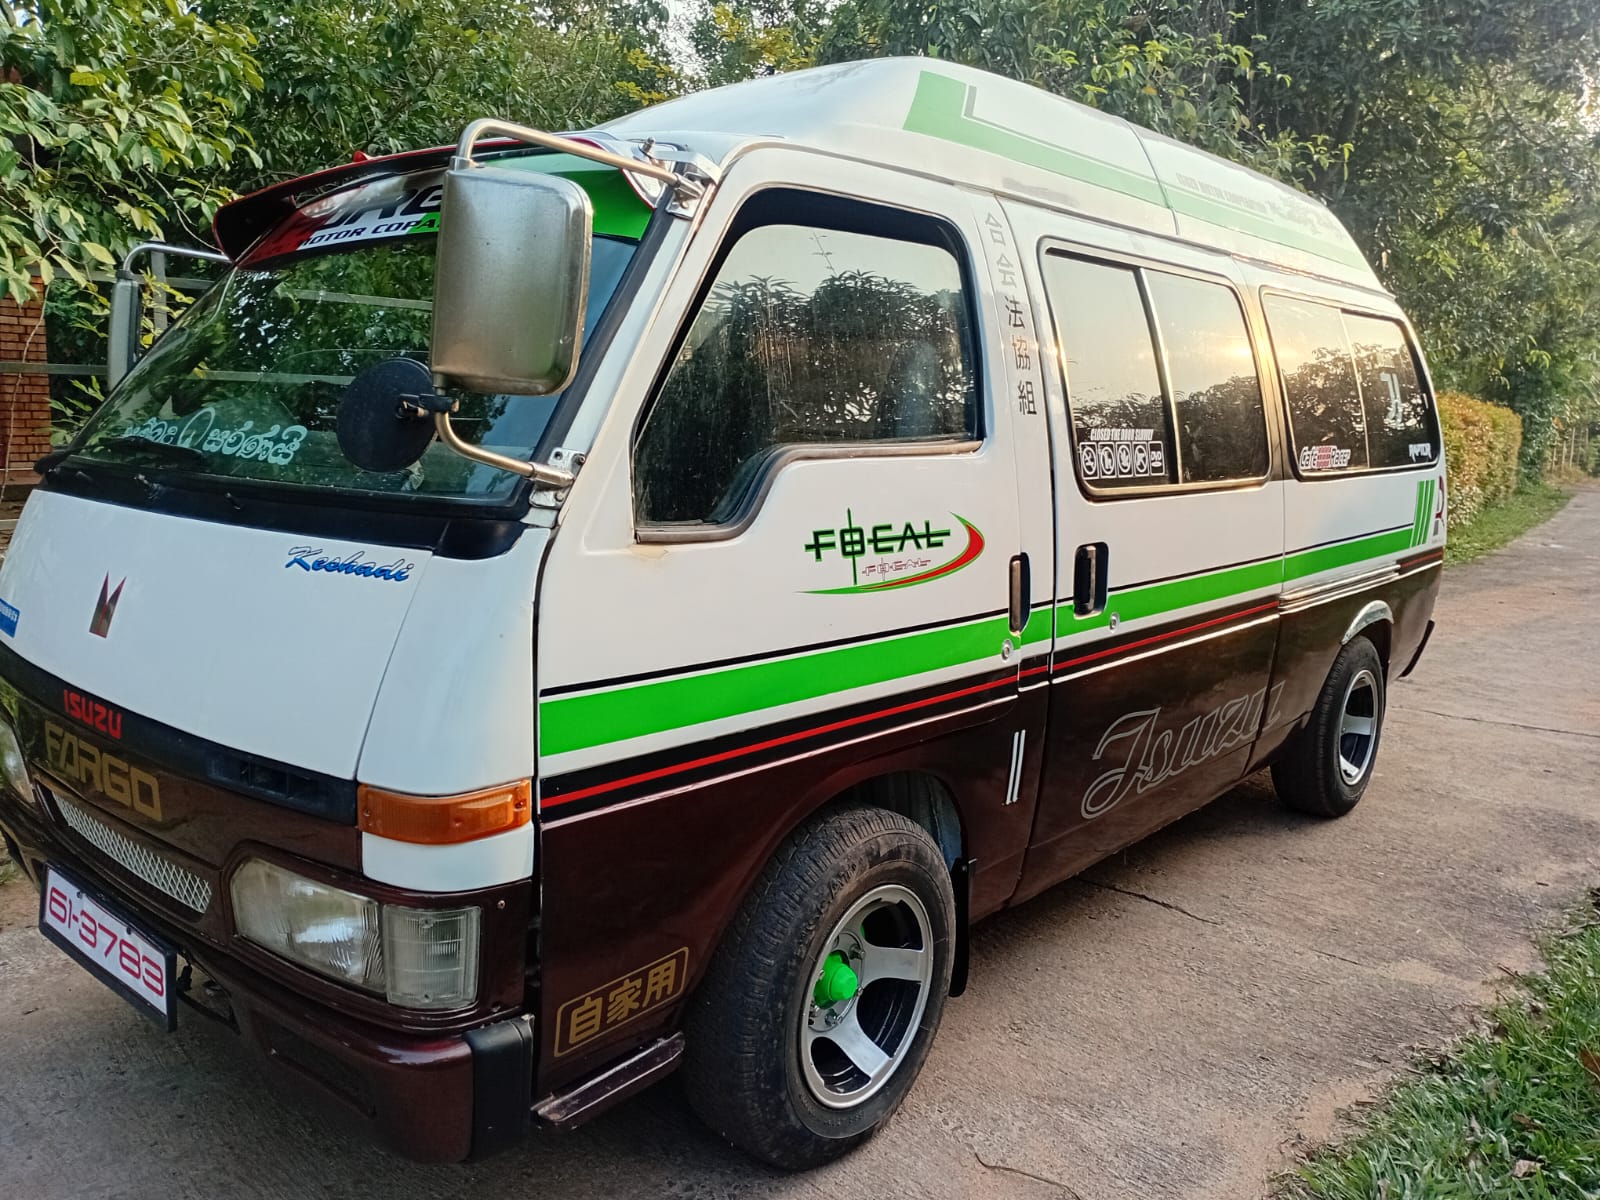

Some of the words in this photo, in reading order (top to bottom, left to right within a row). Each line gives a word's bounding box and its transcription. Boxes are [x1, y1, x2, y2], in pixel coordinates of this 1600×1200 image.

[371, 218, 440, 234] COPA
[804, 510, 951, 576] FOCAL
[63, 689, 123, 740] ISUZU
[44, 720, 162, 822] FARGO
[49, 886, 164, 997] 61-3783
[568, 958, 677, 1045] 自家用
